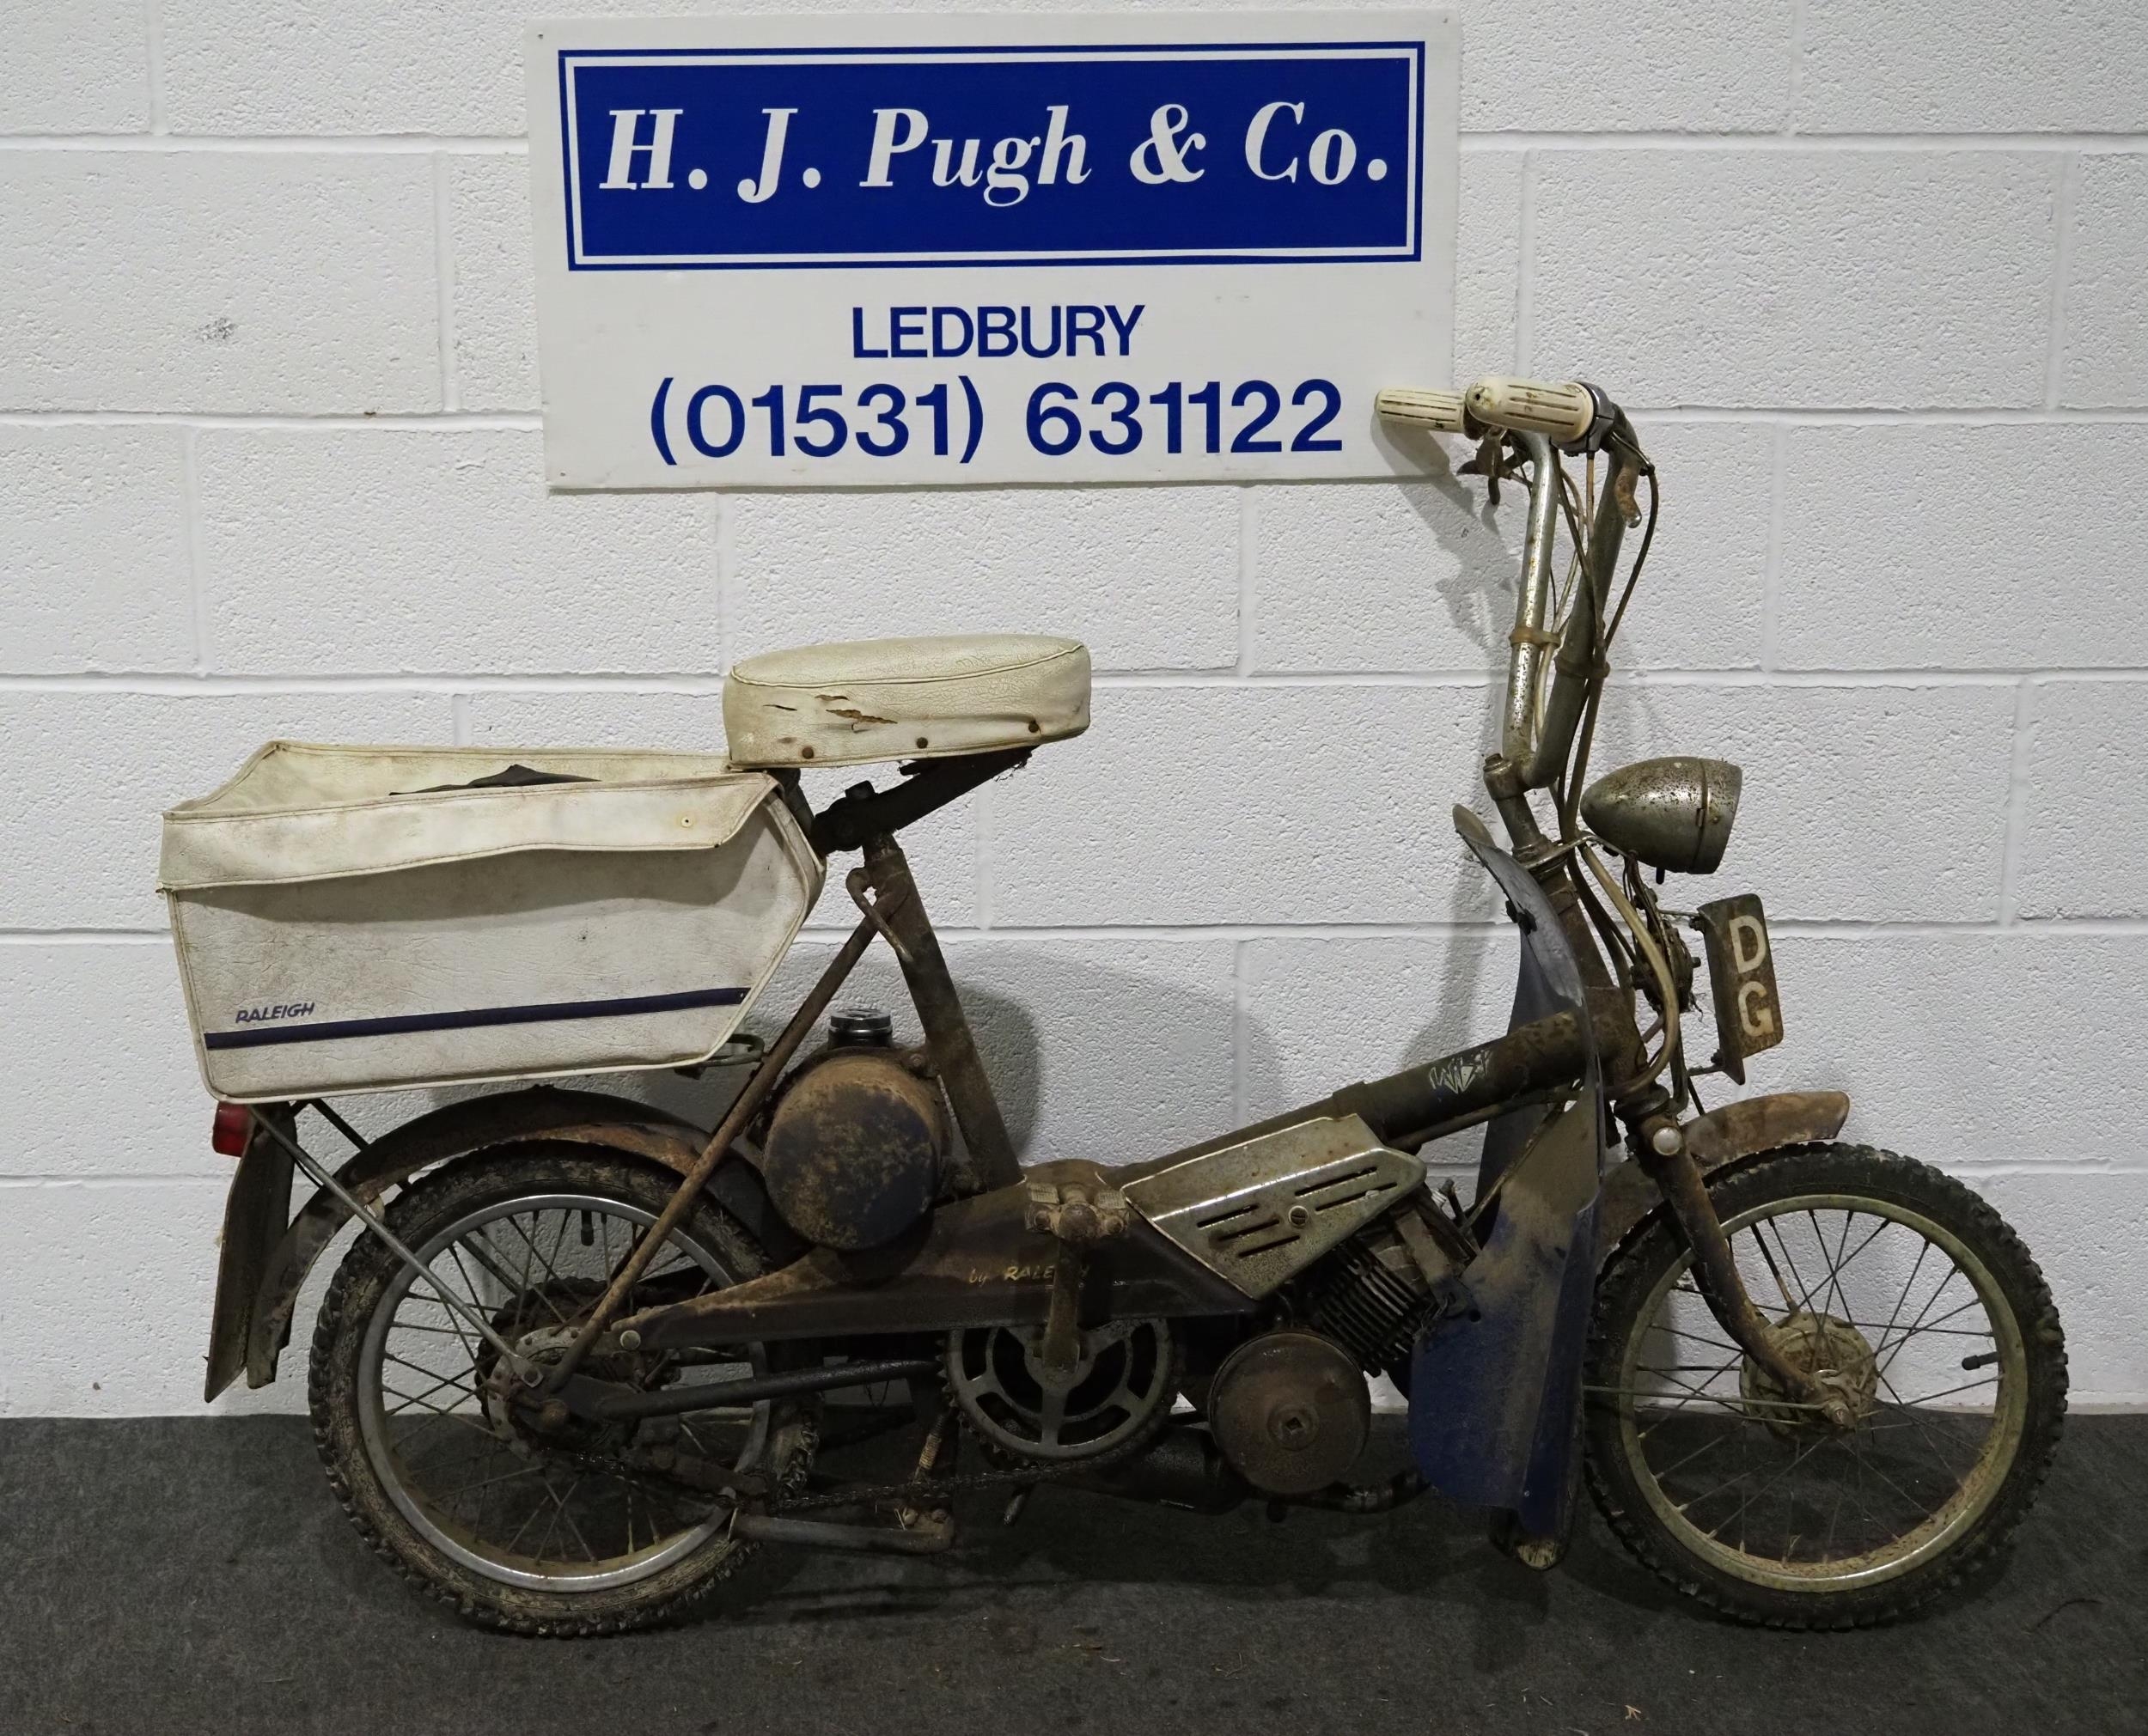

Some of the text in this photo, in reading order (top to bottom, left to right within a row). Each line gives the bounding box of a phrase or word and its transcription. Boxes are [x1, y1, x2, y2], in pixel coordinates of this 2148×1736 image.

[599, 101, 1388, 207] H. J. Pugh & Co.
[852, 304, 1145, 359] LEDBURY
[650, 375, 1343, 466] (01531) 631122
[235, 1002, 315, 1024] RALEIGH
